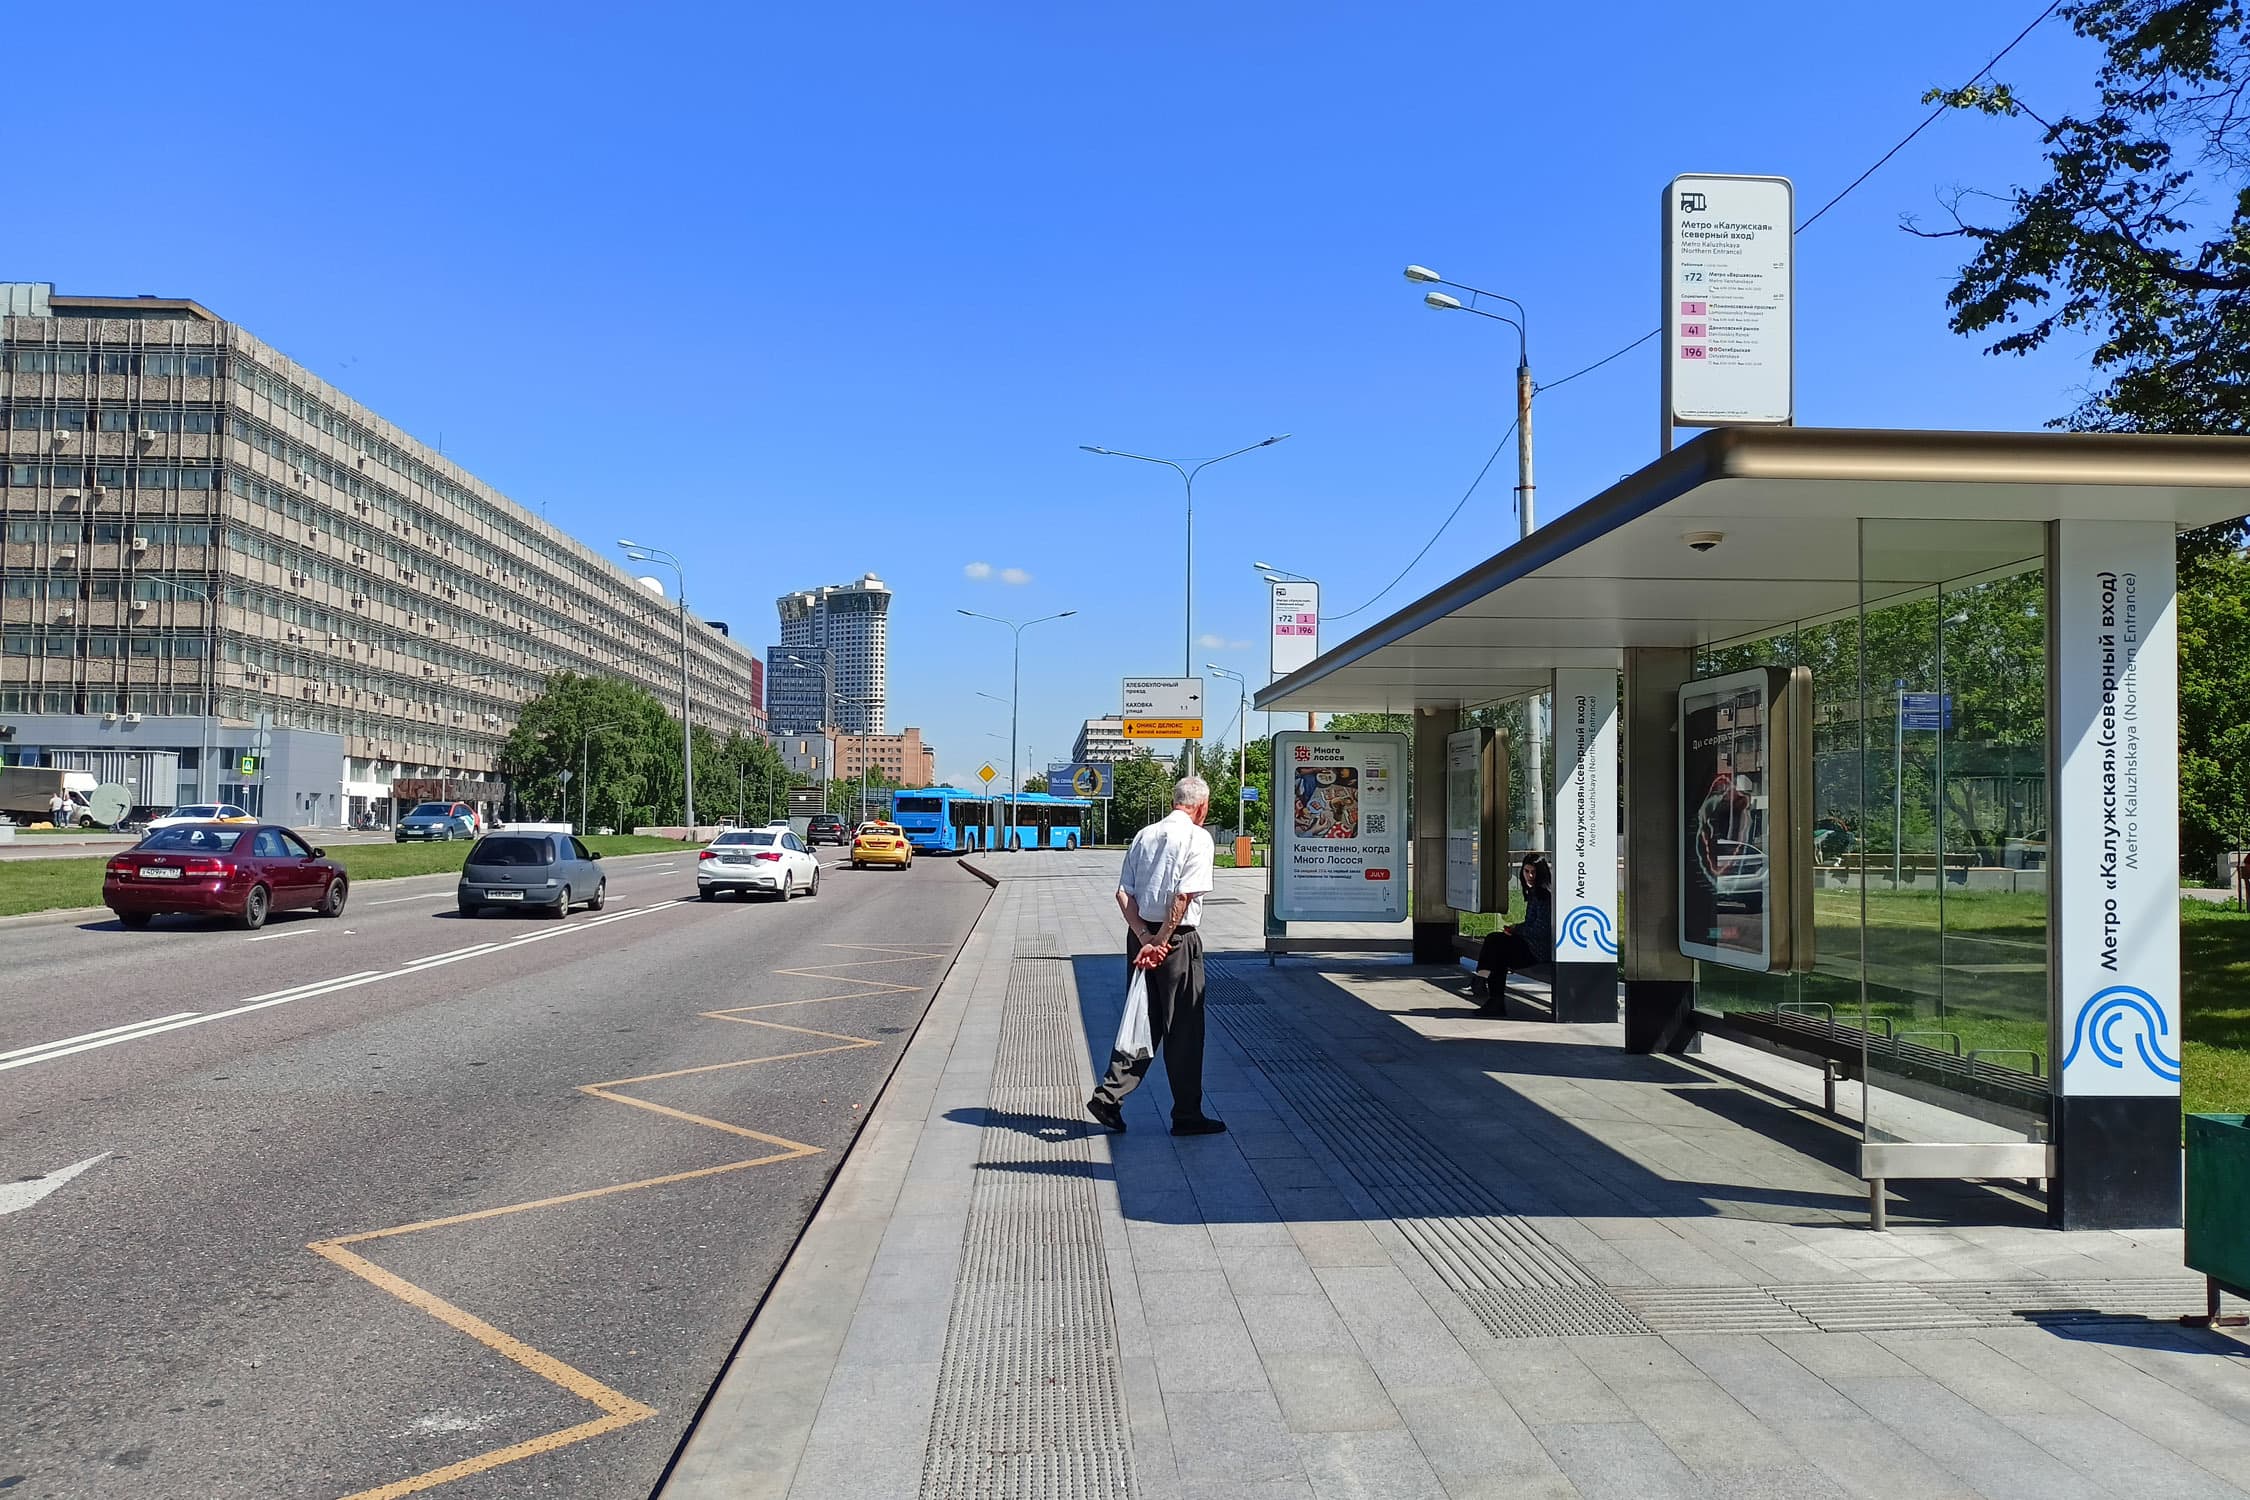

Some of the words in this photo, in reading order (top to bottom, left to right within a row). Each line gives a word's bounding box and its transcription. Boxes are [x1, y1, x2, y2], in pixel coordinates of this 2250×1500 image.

[1681, 220, 1712, 230] Метро
[1714, 222, 1773, 231] «Калужская»
[1681, 230, 1729, 240] (северный
[1730, 232, 1755, 240] вход)
[1684, 272, 1702, 281] т72
[1690, 304, 1696, 313] 1
[1688, 326, 1698, 335] 41
[1684, 348, 1702, 357] 196
[2097, 571, 2118, 628] вход)
[2122, 572, 2138, 643] Entrance)
[2123, 646, 2139, 721] (Northern
[1575, 695, 1586, 724] вход)
[1588, 696, 1596, 732] Entrance)
[1588, 734, 1597, 772] (Northern
[2124, 726, 2140, 818] Kaluzhskaya
[1588, 774, 1597, 821] Kaluzhskaya
[1294, 844, 1360, 854] Качественно,
[1362, 846, 1390, 855] когда
[1588, 823, 1596, 847] Metro
[2125, 822, 2139, 870] Metro
[1294, 856, 1324, 864] Много
[1326, 856, 1363, 864] Лосося
[1575, 861, 1586, 898] Метро
[2100, 898, 2120, 972] Метро
